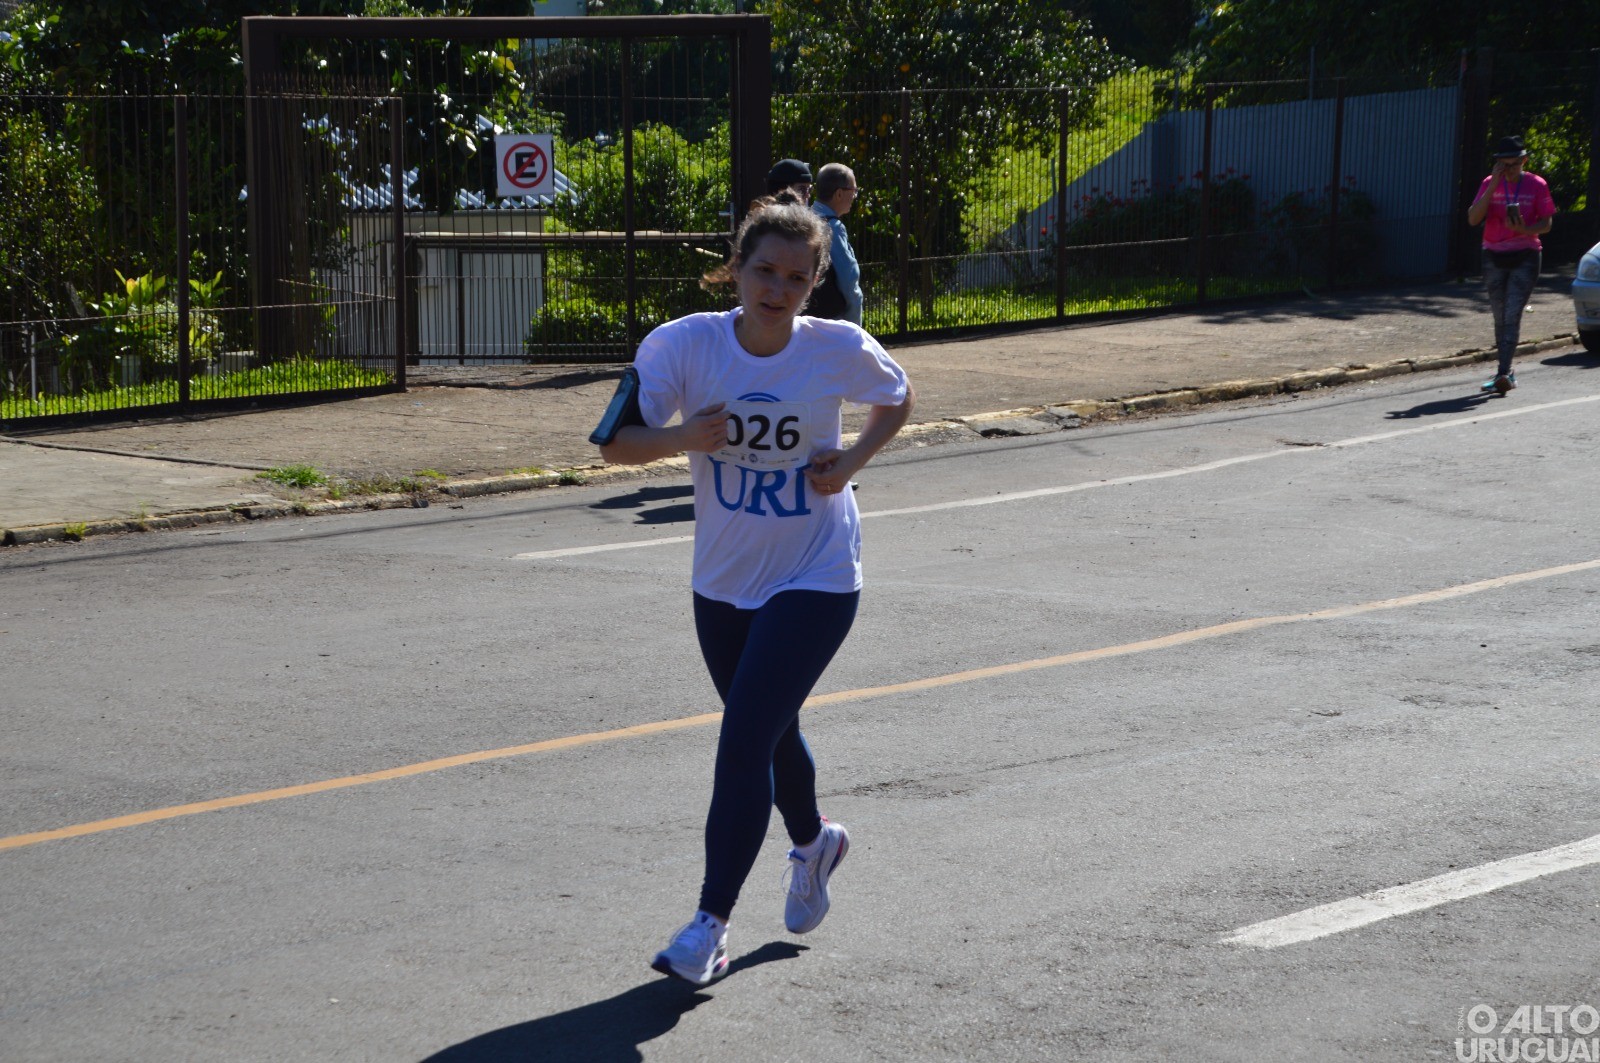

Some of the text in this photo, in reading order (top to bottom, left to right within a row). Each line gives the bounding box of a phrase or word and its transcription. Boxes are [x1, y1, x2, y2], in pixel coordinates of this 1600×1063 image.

[515, 151, 537, 178] E
[726, 413, 800, 451] 026
[707, 454, 812, 517] URI
